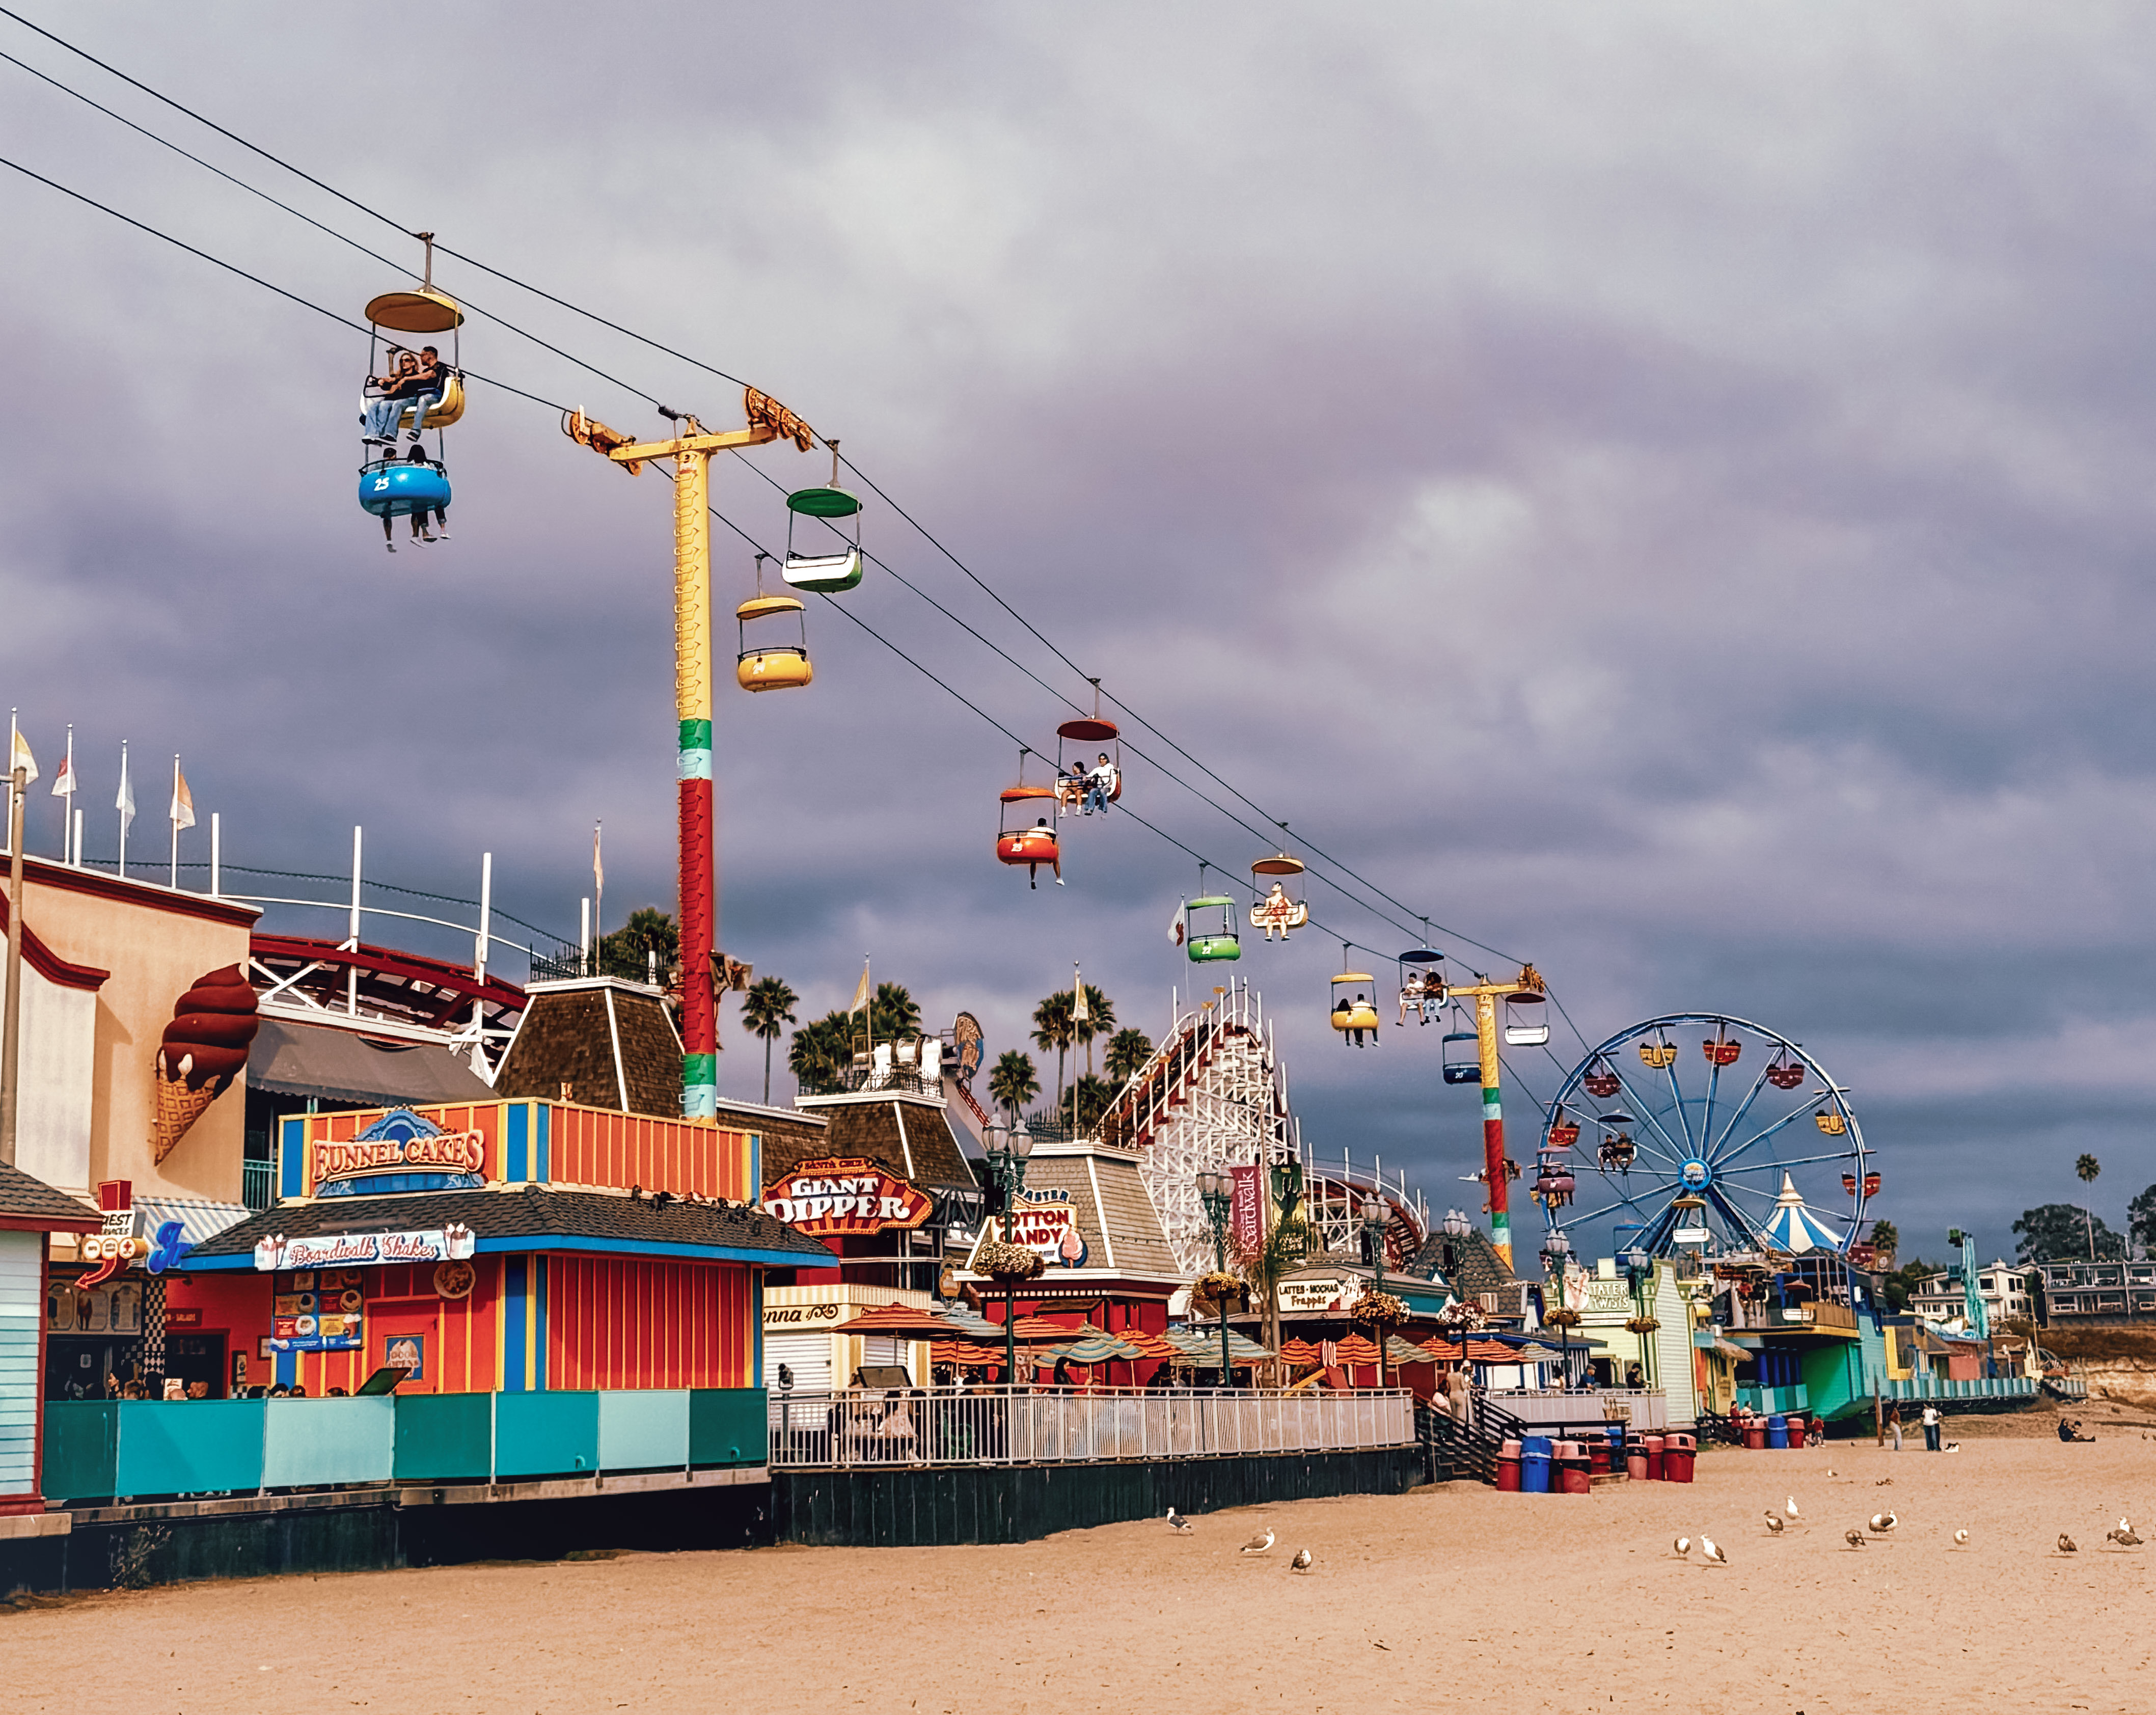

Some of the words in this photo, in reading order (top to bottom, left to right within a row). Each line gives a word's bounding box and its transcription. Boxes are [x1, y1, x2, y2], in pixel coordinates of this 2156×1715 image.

[374, 477, 390, 492] 25
[313, 1140, 403, 1181] FUNNEL
[405, 1130, 483, 1172] CAKES
[791, 1178, 879, 1196] GIANT
[764, 1196, 910, 1222] DIPPER
[995, 1210, 1069, 1229] COTTON
[999, 1228, 1063, 1245] CANDY
[290, 1236, 379, 1267] Boardwalk
[383, 1235, 441, 1260] Shakes
[1279, 1285, 1304, 1295] LATTES
[1309, 1284, 1339, 1294] MOCHAS
[1591, 1284, 1627, 1295] TATER
[1592, 1297, 1629, 1309] TWISTS
